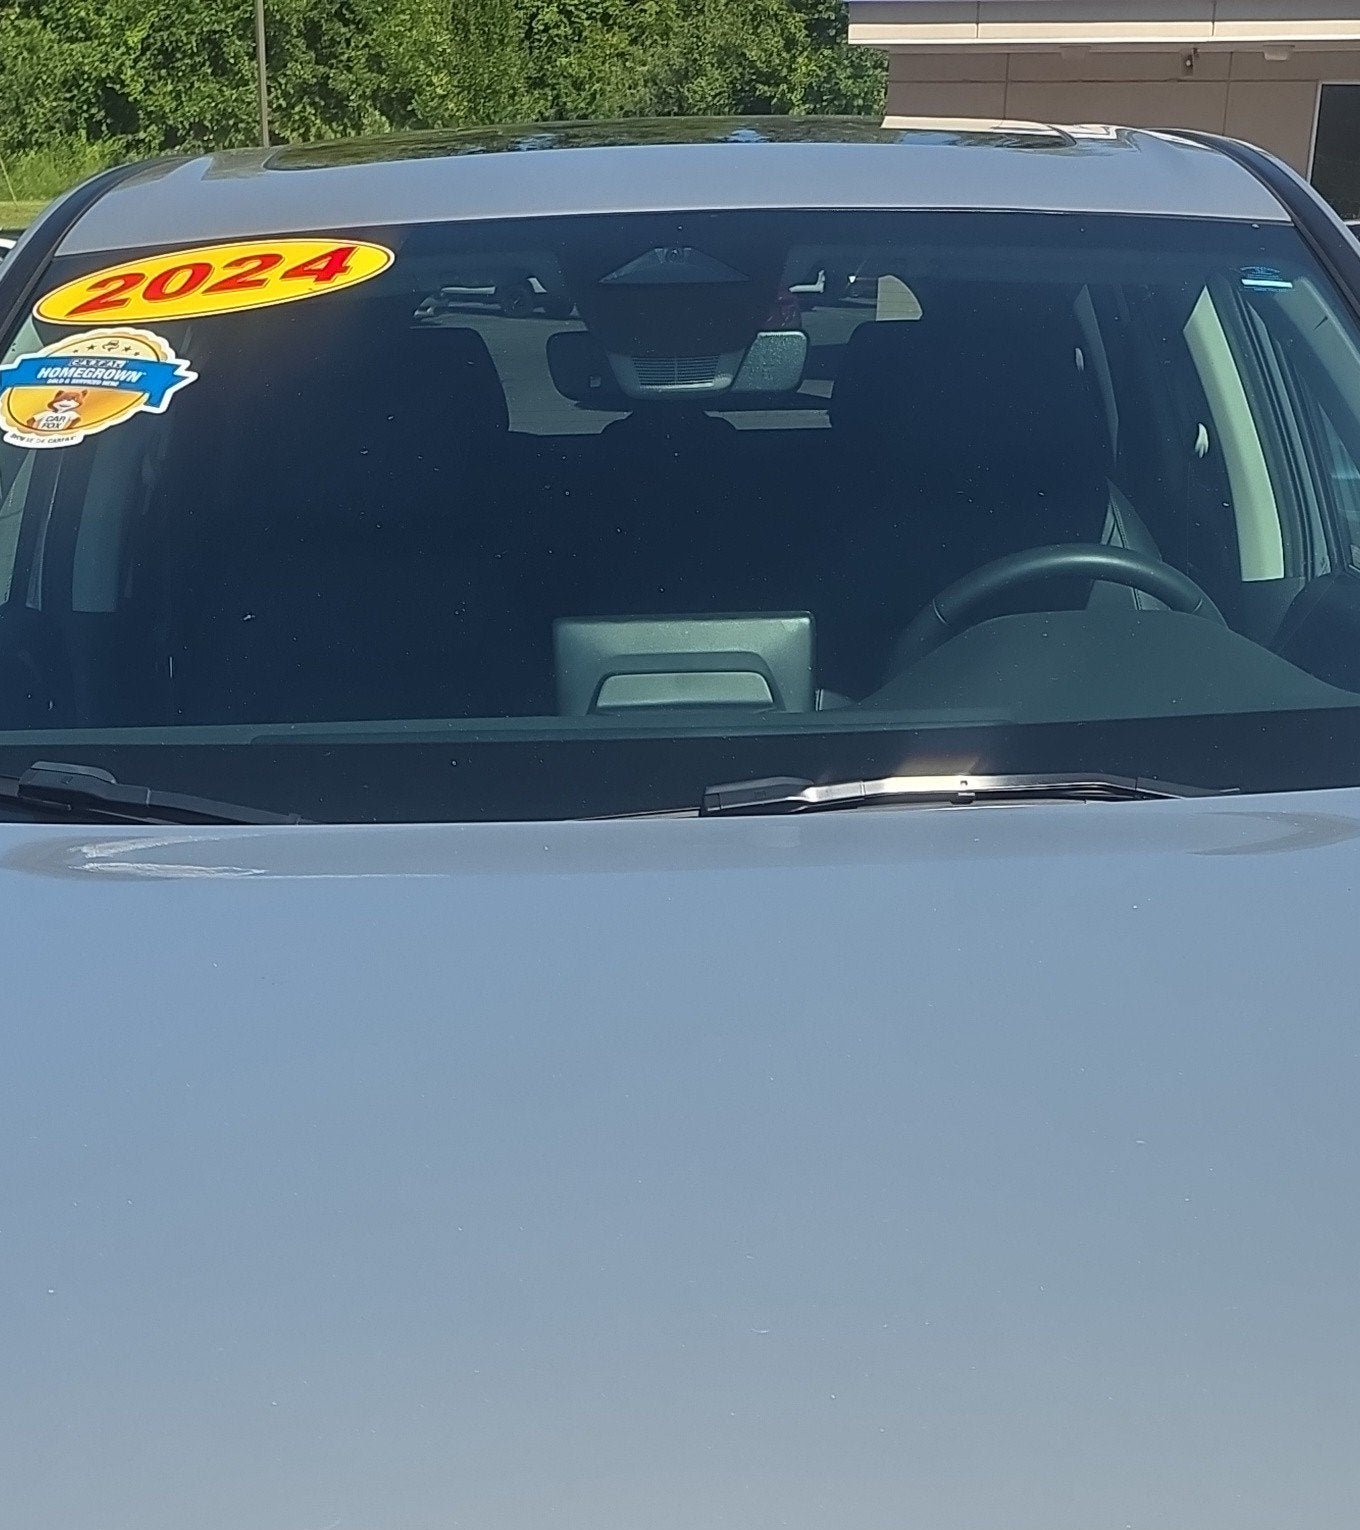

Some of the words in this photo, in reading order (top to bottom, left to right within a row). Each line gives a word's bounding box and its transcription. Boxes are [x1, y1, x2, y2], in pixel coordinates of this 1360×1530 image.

[66, 245, 362, 317] 2024
[36, 367, 143, 383] HOMEGROWN
[45, 415, 66, 423] CAR
[42, 422, 62, 430] FOX
